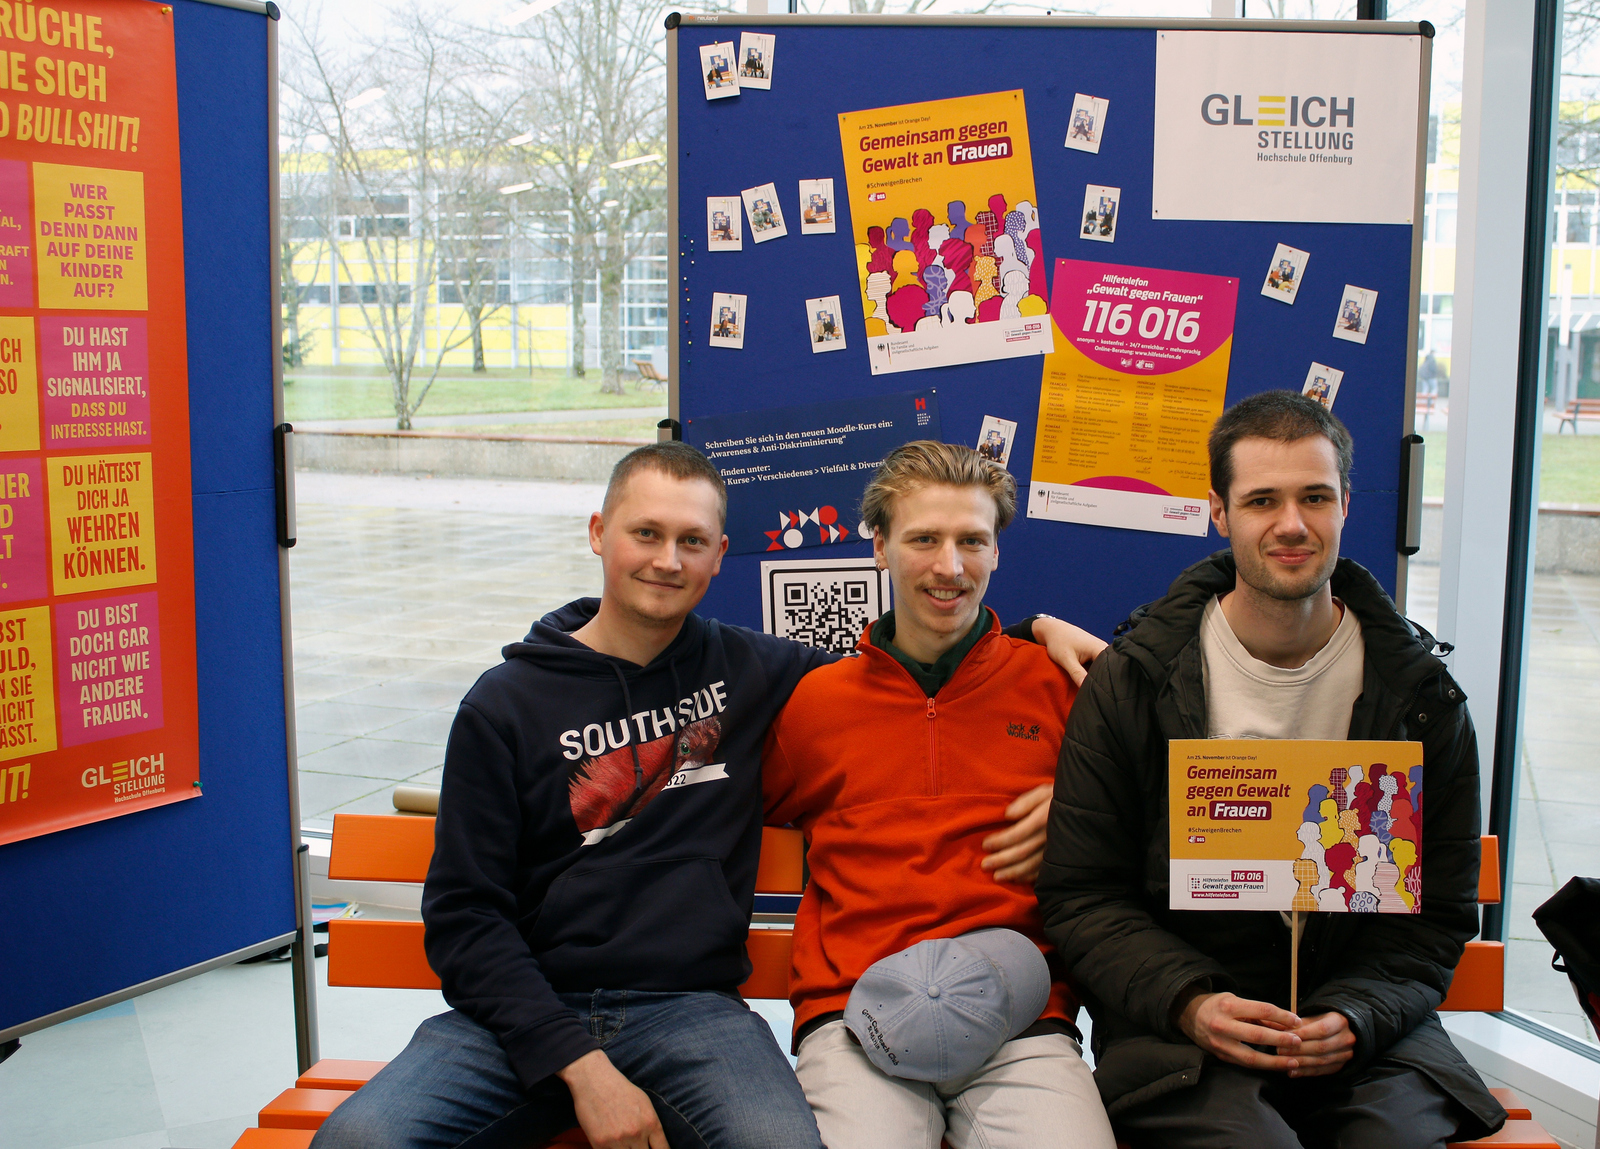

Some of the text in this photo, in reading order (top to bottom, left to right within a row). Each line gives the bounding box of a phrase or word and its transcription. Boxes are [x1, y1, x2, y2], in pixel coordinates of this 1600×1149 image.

[35, 56, 107, 103] SICH
[1200, 93, 1355, 128] GLEICH
[17, 103, 140, 153] BULLSHIT!
[860, 121, 1008, 152] Gemeinsam gegen
[1257, 130, 1354, 151] STELLUNG
[862, 142, 1008, 173] Gewalt an Frauen
[1257, 152, 1353, 165] Hochschule Offenburg
[70, 183, 108, 201] WER
[866, 177, 923, 189] #SchweigenBrechen
[64, 203, 115, 220] PASST
[41, 221, 138, 242] DENN DANN
[47, 242, 134, 260] AUF DEINE
[61, 262, 123, 279] KINDER
[1102, 274, 1149, 287] Hilfetelefon
[73, 283, 115, 298] AUF?
[1087, 283, 1129, 297] „Gewalt
[1129, 288, 1161, 301] gegen
[1082, 299, 1201, 343] 116 016
[63, 327, 129, 347] DU HAST
[73, 352, 122, 373] IHM JA
[47, 377, 147, 398] SIGNALISIERT,
[71, 402, 126, 417] DASS DU
[51, 421, 147, 440] INTERESSE HAST.
[705, 420, 893, 450] Schreiben Sie sich in den neuen Moodle-Kurs ein:
[752, 446, 759, 454] &
[63, 460, 141, 487] DU HÄTTEST
[720, 465, 771, 477] finden unter:
[727, 477, 750, 486] Kurse
[756, 468, 814, 482] Verschiedenes
[820, 463, 849, 474] Vielfalt
[77, 488, 129, 511] DICH JA
[67, 511, 140, 545] WEHREN
[64, 545, 146, 580] KÖNNEN.
[77, 603, 138, 630] DU BIST
[69, 626, 149, 657] DOCH GAR
[71, 651, 150, 682] NICHT WIE
[11, 675, 33, 697] SIE
[79, 675, 144, 705] ANDERE
[83, 699, 149, 728] FRAUEN.
[559, 680, 728, 761] SOUTHSIDE
[81, 752, 165, 789] GLEICH
[1187, 765, 1277, 779] Gemeinsam
[114, 773, 165, 795] STELLUNG
[1186, 783, 1291, 800] gegen Gewalt
[114, 791, 142, 803] Hochschule
[1187, 803, 1268, 817] an Frauen
[1233, 872, 1262, 880] 116 016
